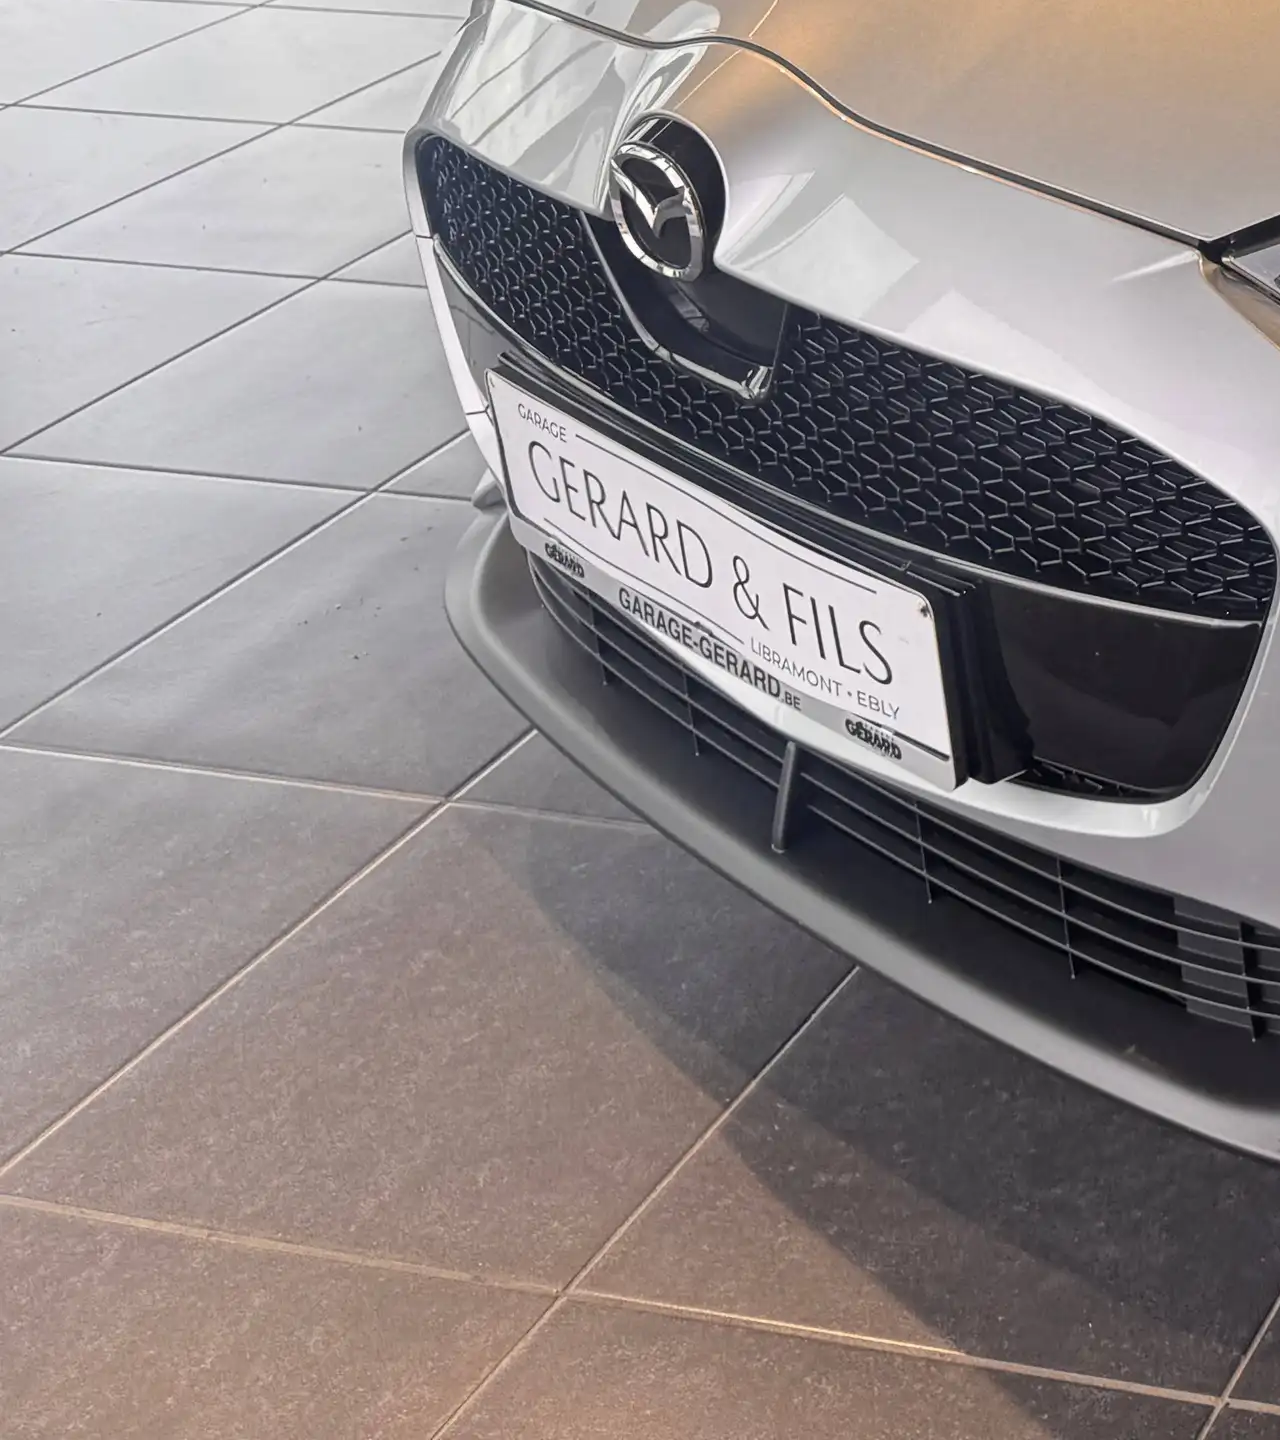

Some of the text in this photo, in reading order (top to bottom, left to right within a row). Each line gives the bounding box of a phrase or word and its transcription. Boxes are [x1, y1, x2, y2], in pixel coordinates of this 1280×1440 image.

[516, 402, 568, 444] GARAGE
[527, 440, 893, 685] GERARD & FILS
[750, 636, 901, 721] LIBRAMONT EBLY
